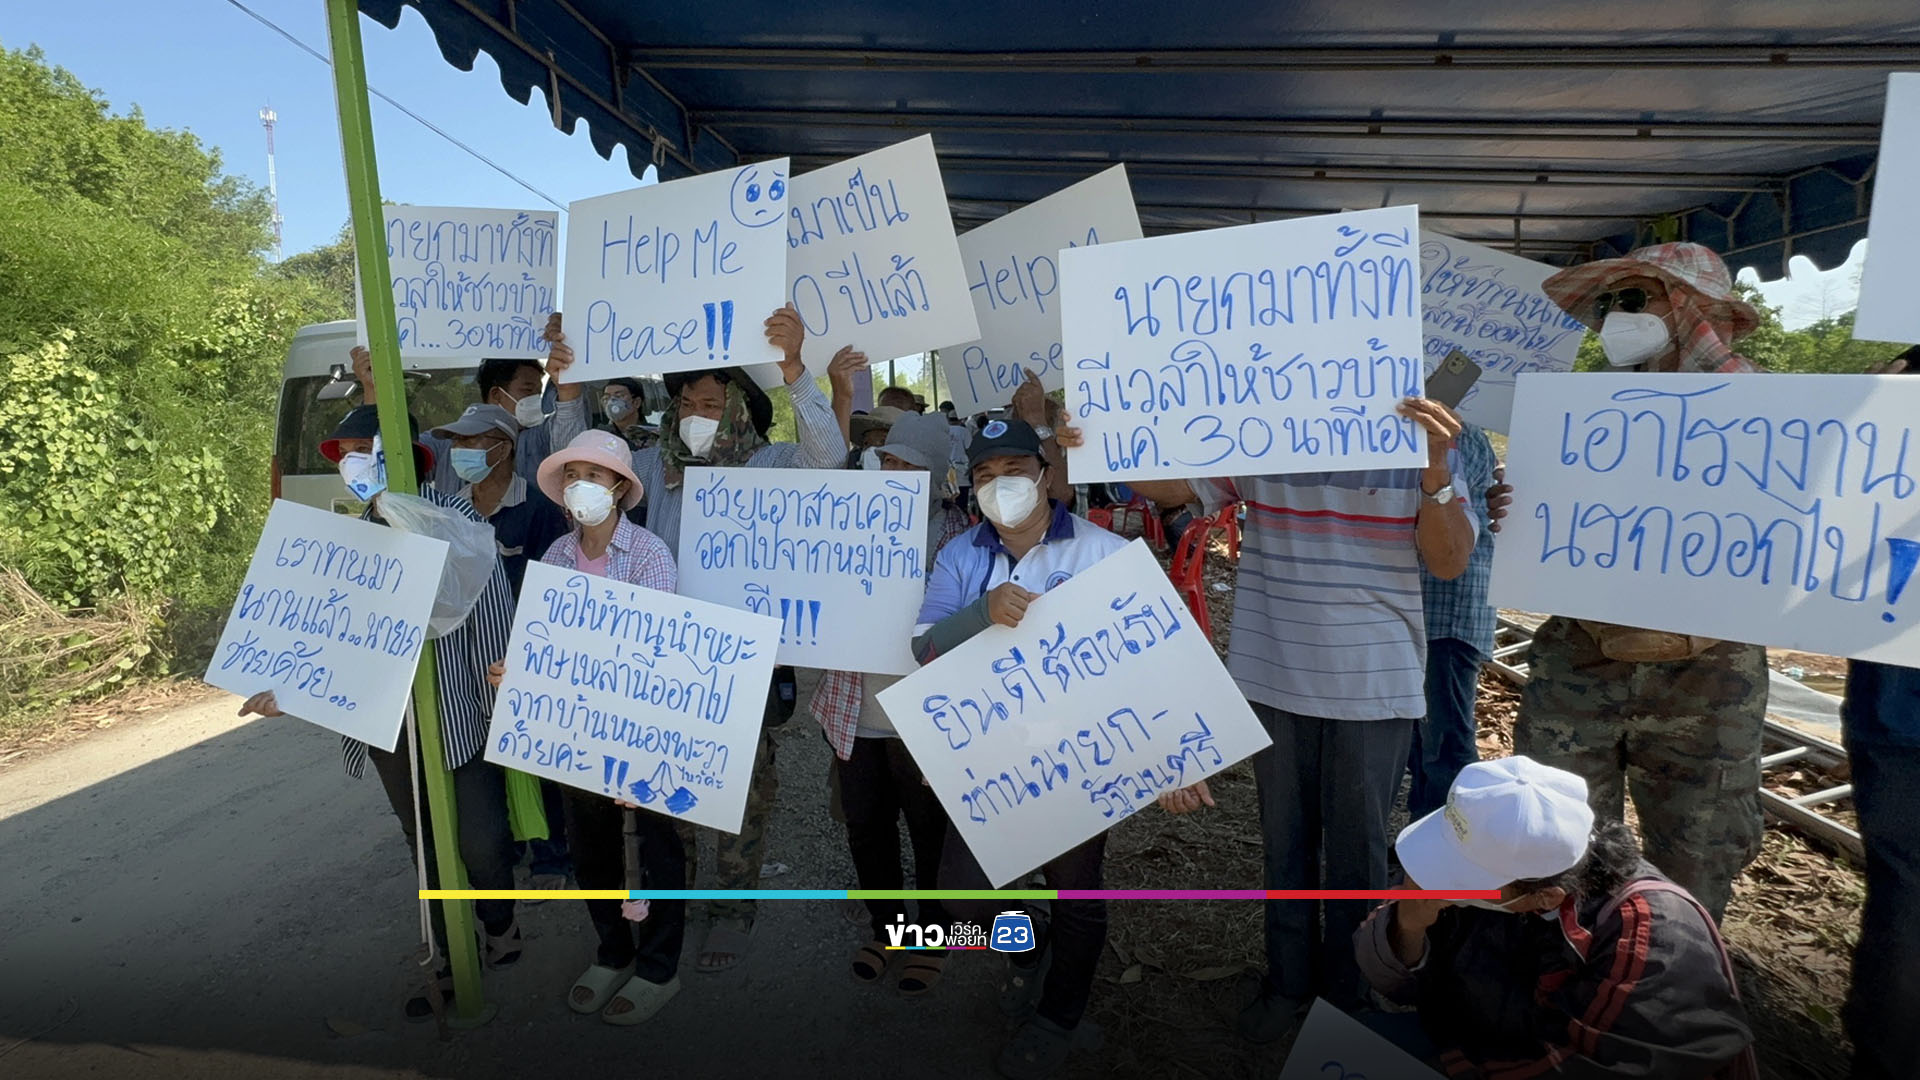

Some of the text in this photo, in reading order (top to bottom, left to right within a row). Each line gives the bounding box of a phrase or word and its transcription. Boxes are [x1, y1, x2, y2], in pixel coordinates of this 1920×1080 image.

[602, 214, 743, 284] Help Me
[825, 251, 930, 326] ปีแล้ว
[1113, 225, 1414, 337] นายกมาทั้งที
[1076, 338, 1422, 419] มีเวลาให้ชาวบ้าน
[1560, 382, 1915, 499] เอาโรงงาน
[695, 472, 921, 533] ช่วยเอาสารเคมี
[275, 537, 403, 594] เราทนมา
[695, 519, 923, 596] ออกไปจากหมู่บ้าน
[543, 575, 758, 666] ขอให้ท่านนำขยะ
[523, 620, 735, 725] พิษเหล่านี้ออกไป
[507, 688, 730, 775] จากบ้านหนองพะวา
[1080, 711, 1223, 819] รัฐมนตรี
